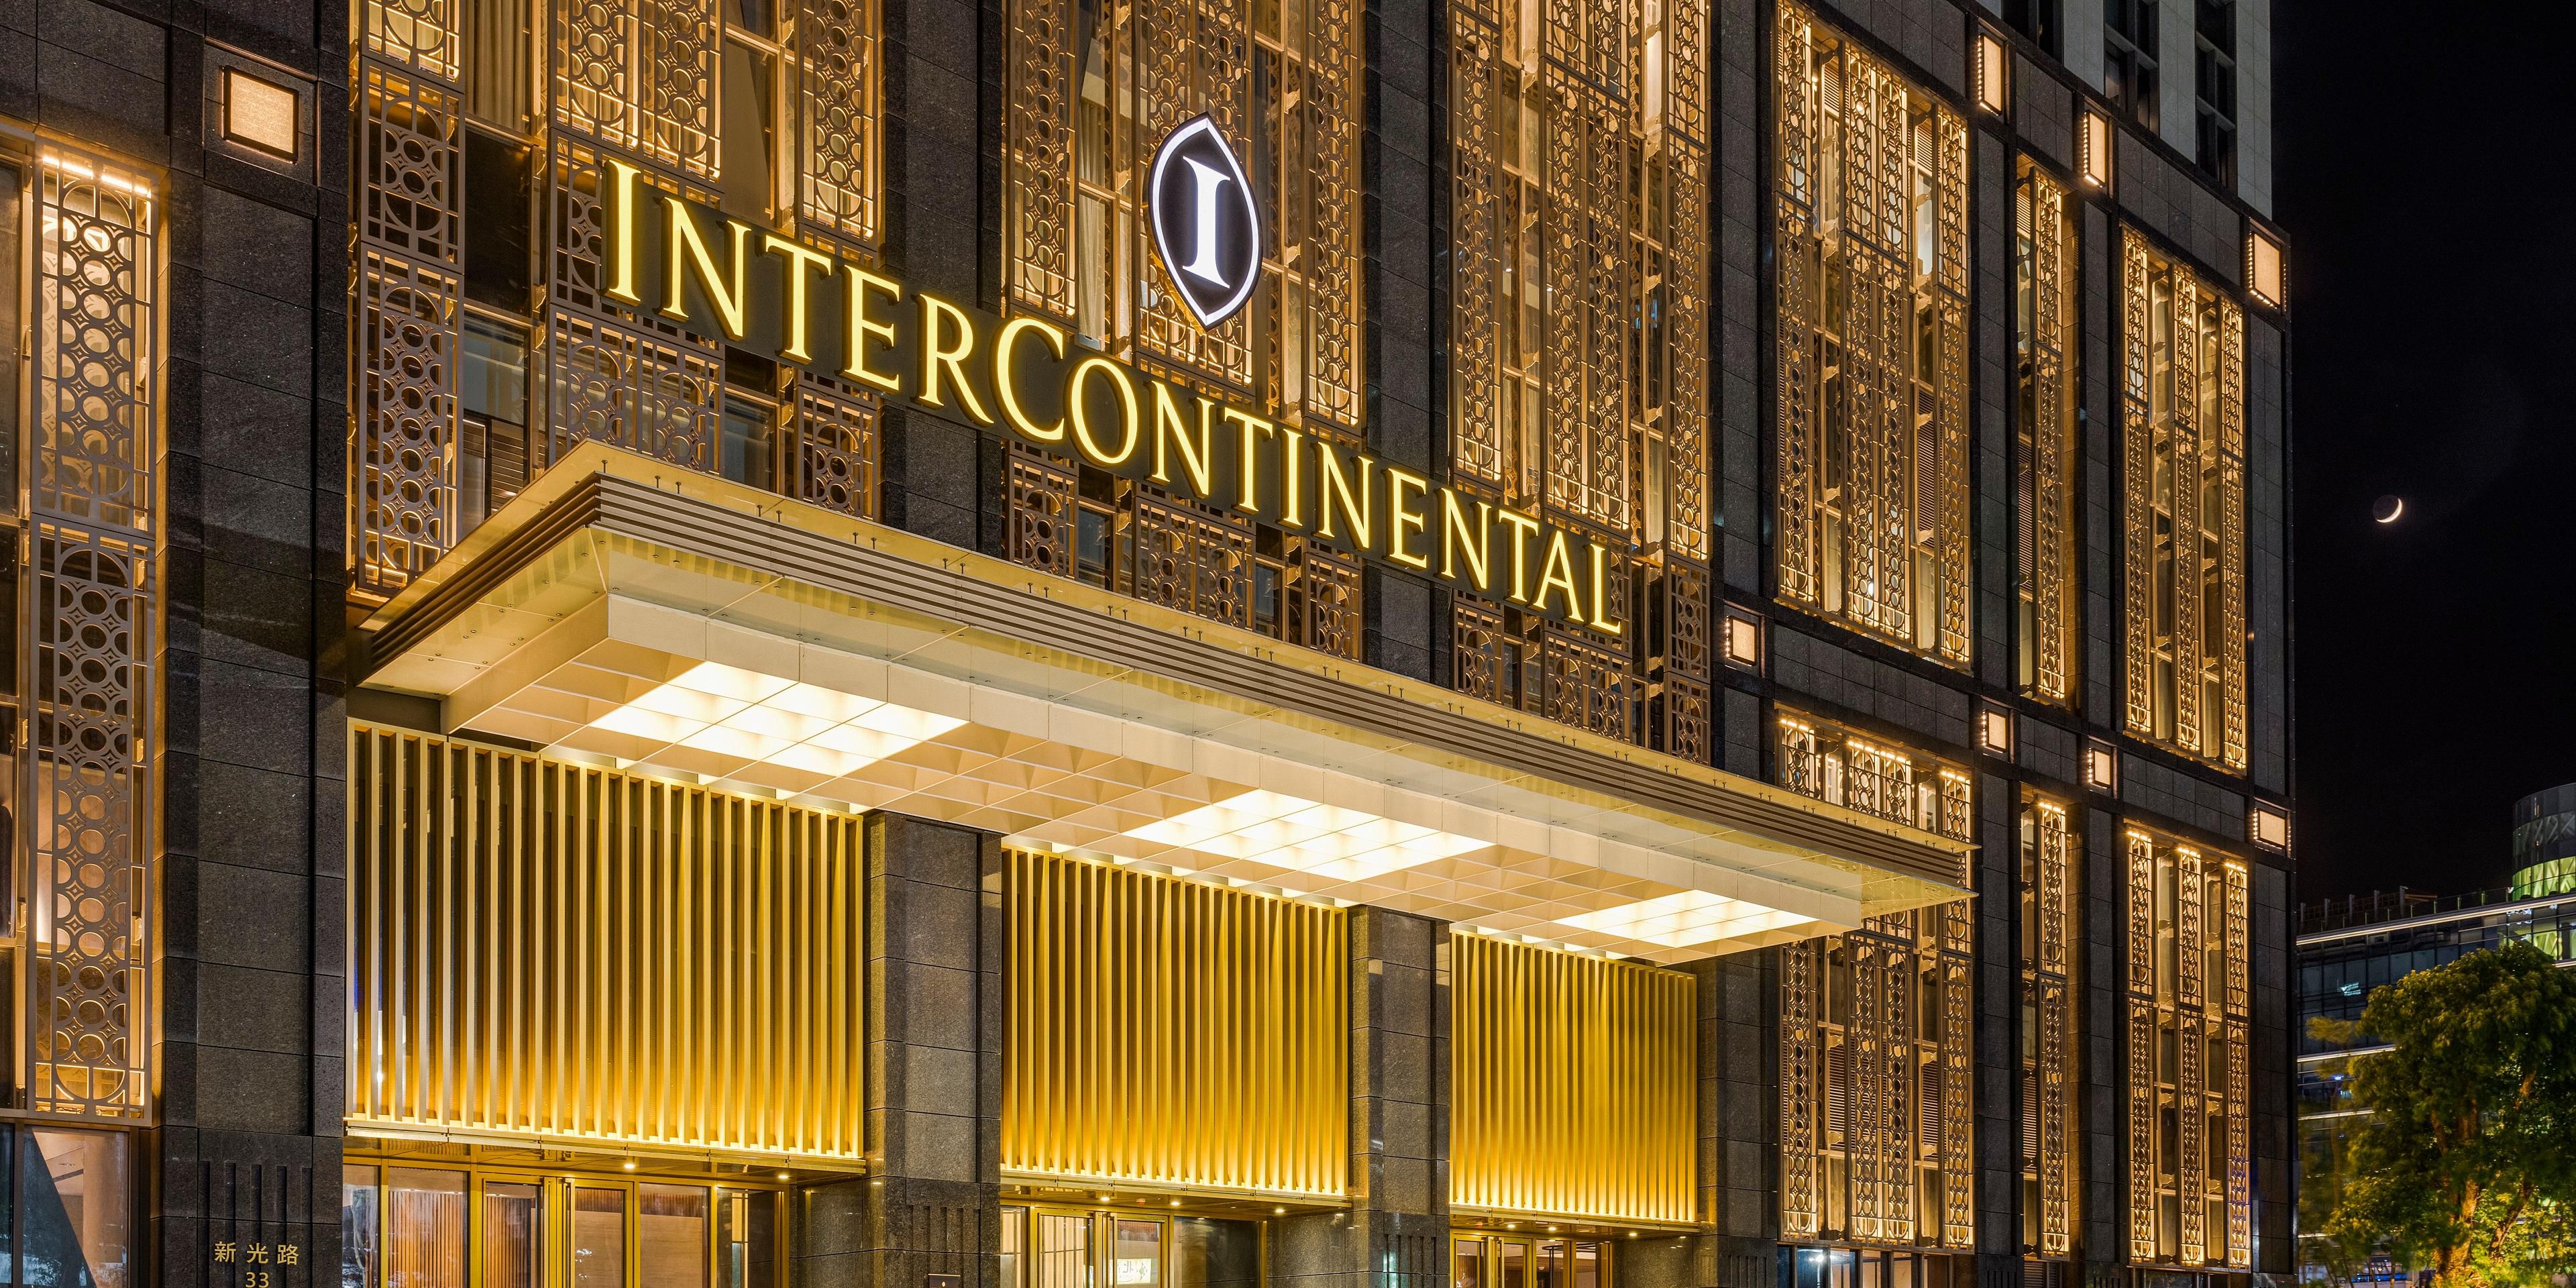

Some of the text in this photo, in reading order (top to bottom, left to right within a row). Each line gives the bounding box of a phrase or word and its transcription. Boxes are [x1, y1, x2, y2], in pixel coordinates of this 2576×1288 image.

[1183, 156, 1230, 289] I
[608, 159, 1621, 635] INTERCONTINENTAL
[214, 1241, 299, 1265] 新光路
[246, 1272, 269, 1288] 33
